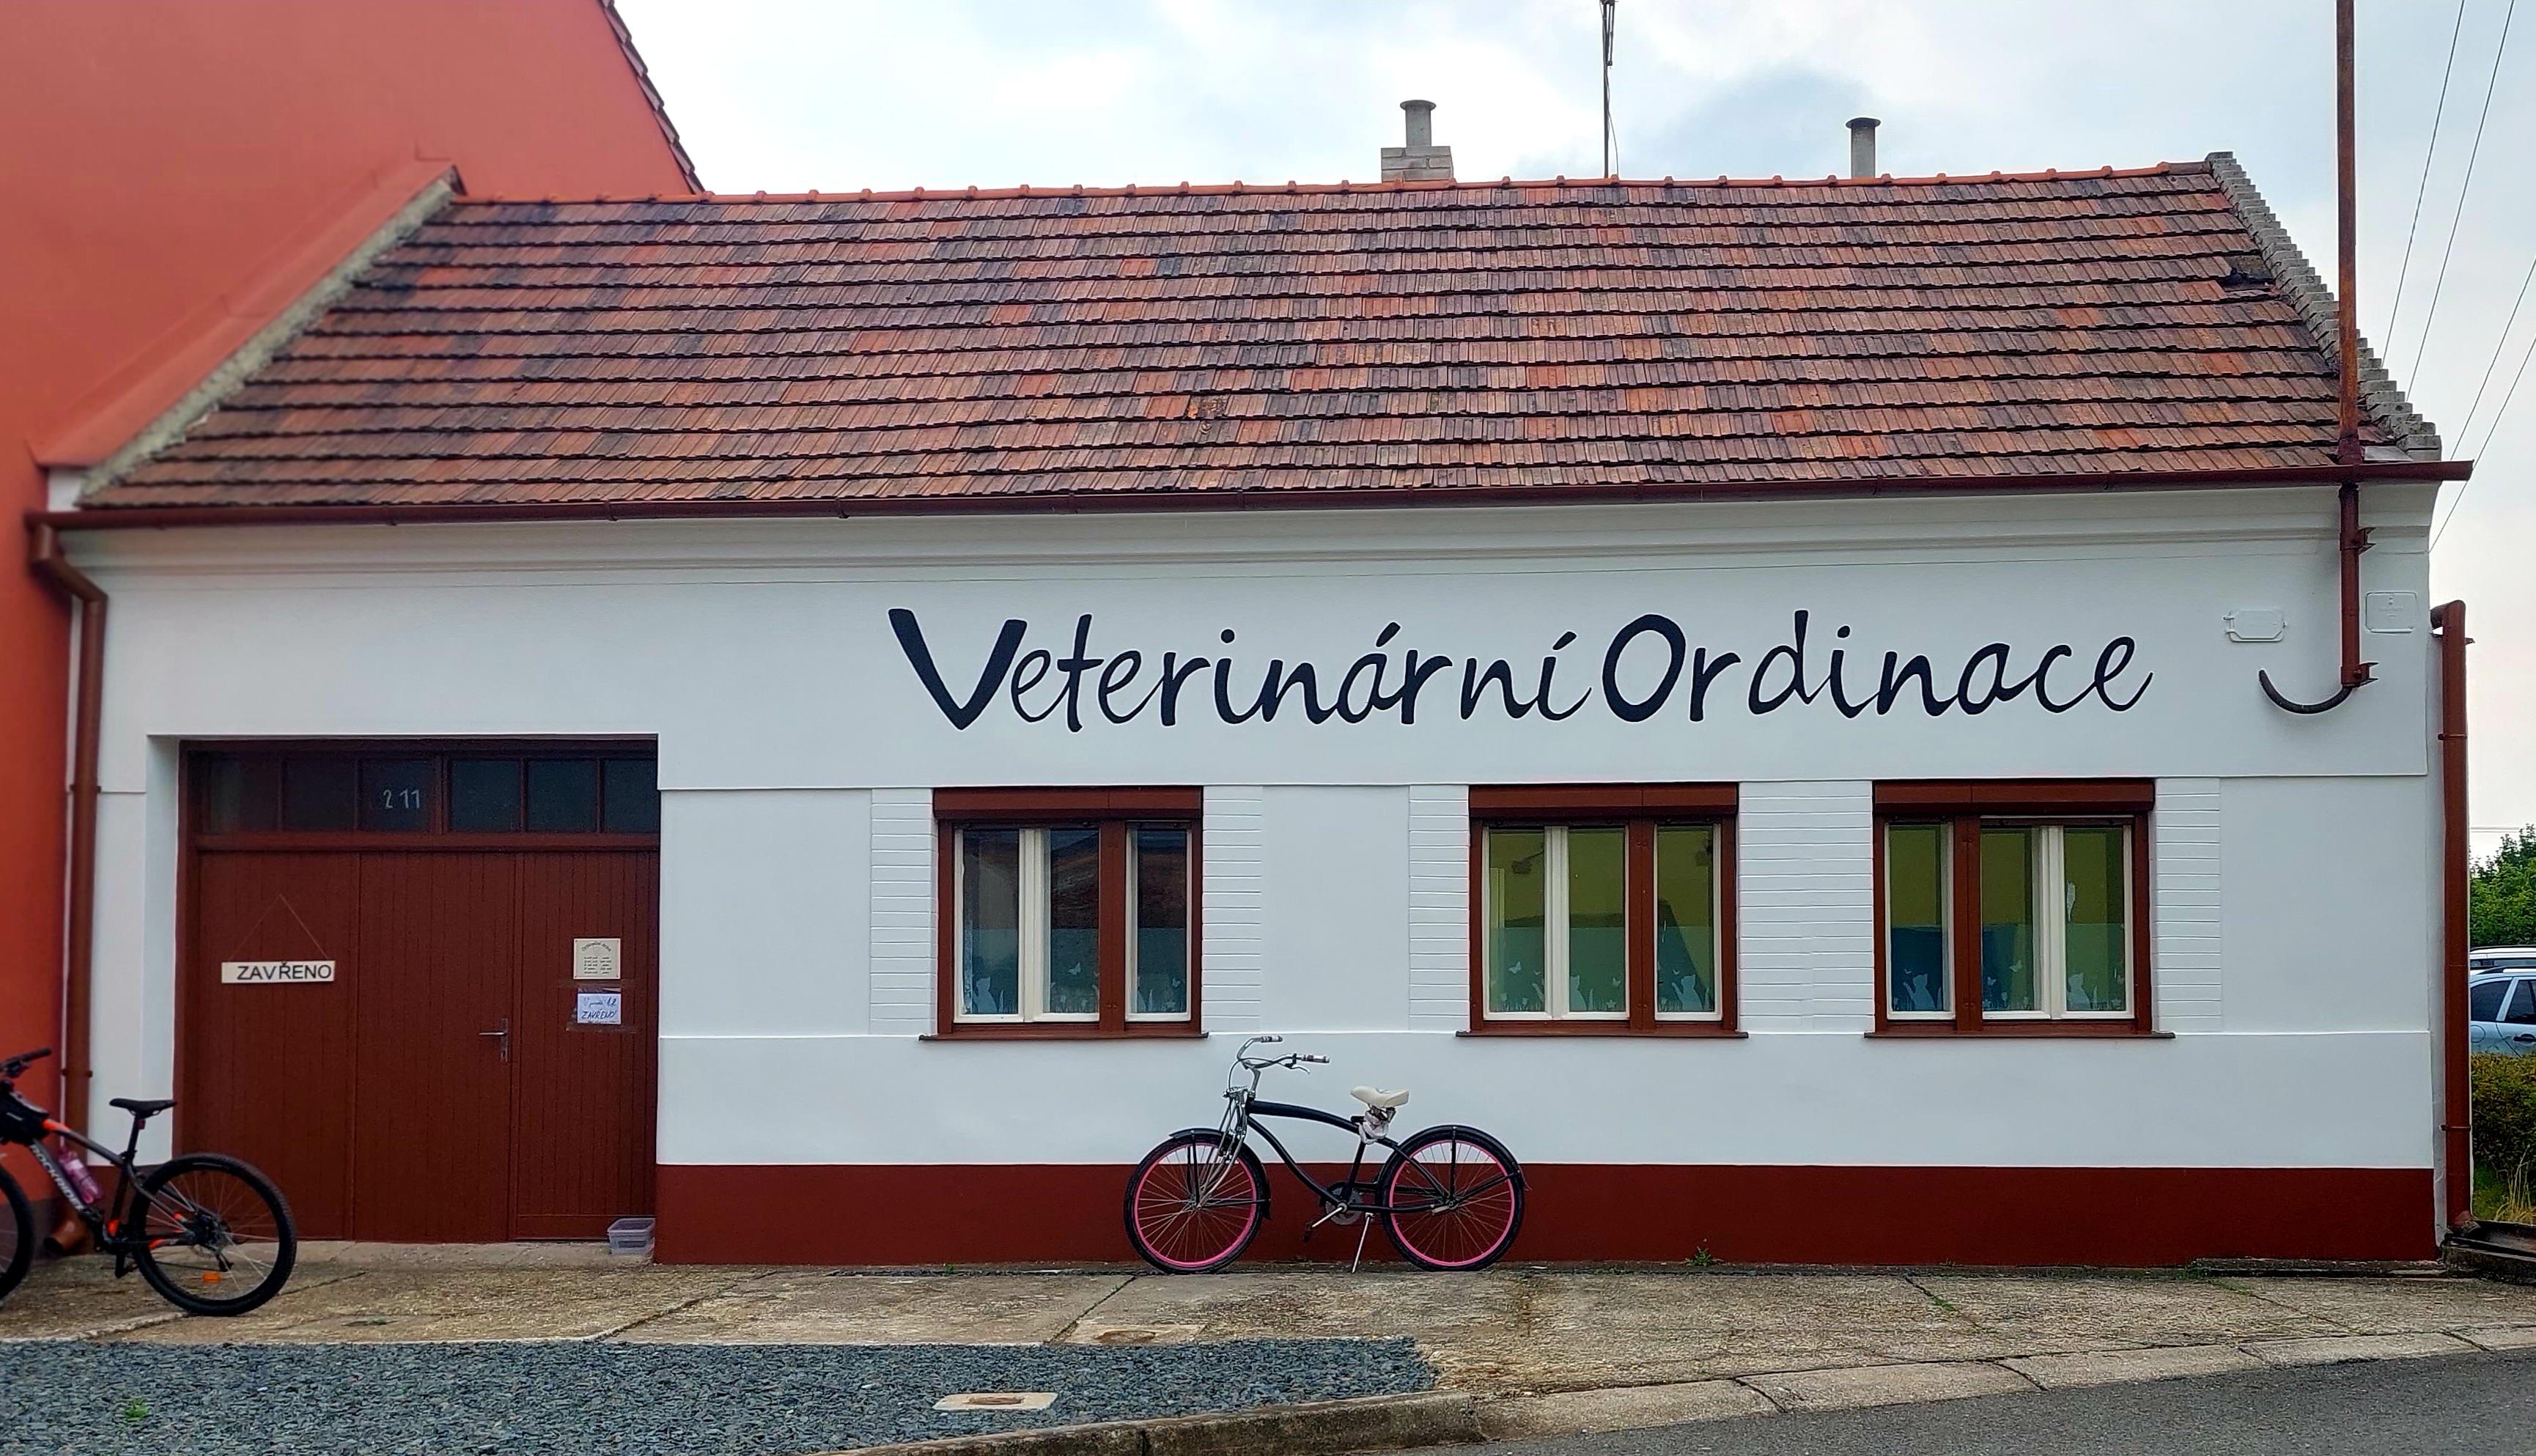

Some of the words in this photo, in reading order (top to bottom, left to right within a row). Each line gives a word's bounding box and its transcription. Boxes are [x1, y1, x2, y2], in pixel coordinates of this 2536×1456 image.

[888, 608, 1592, 733] Veterinární
[1602, 610, 2153, 723] Ordinace
[383, 788, 420, 809] 211
[236, 961, 332, 980] ZAVŘENO
